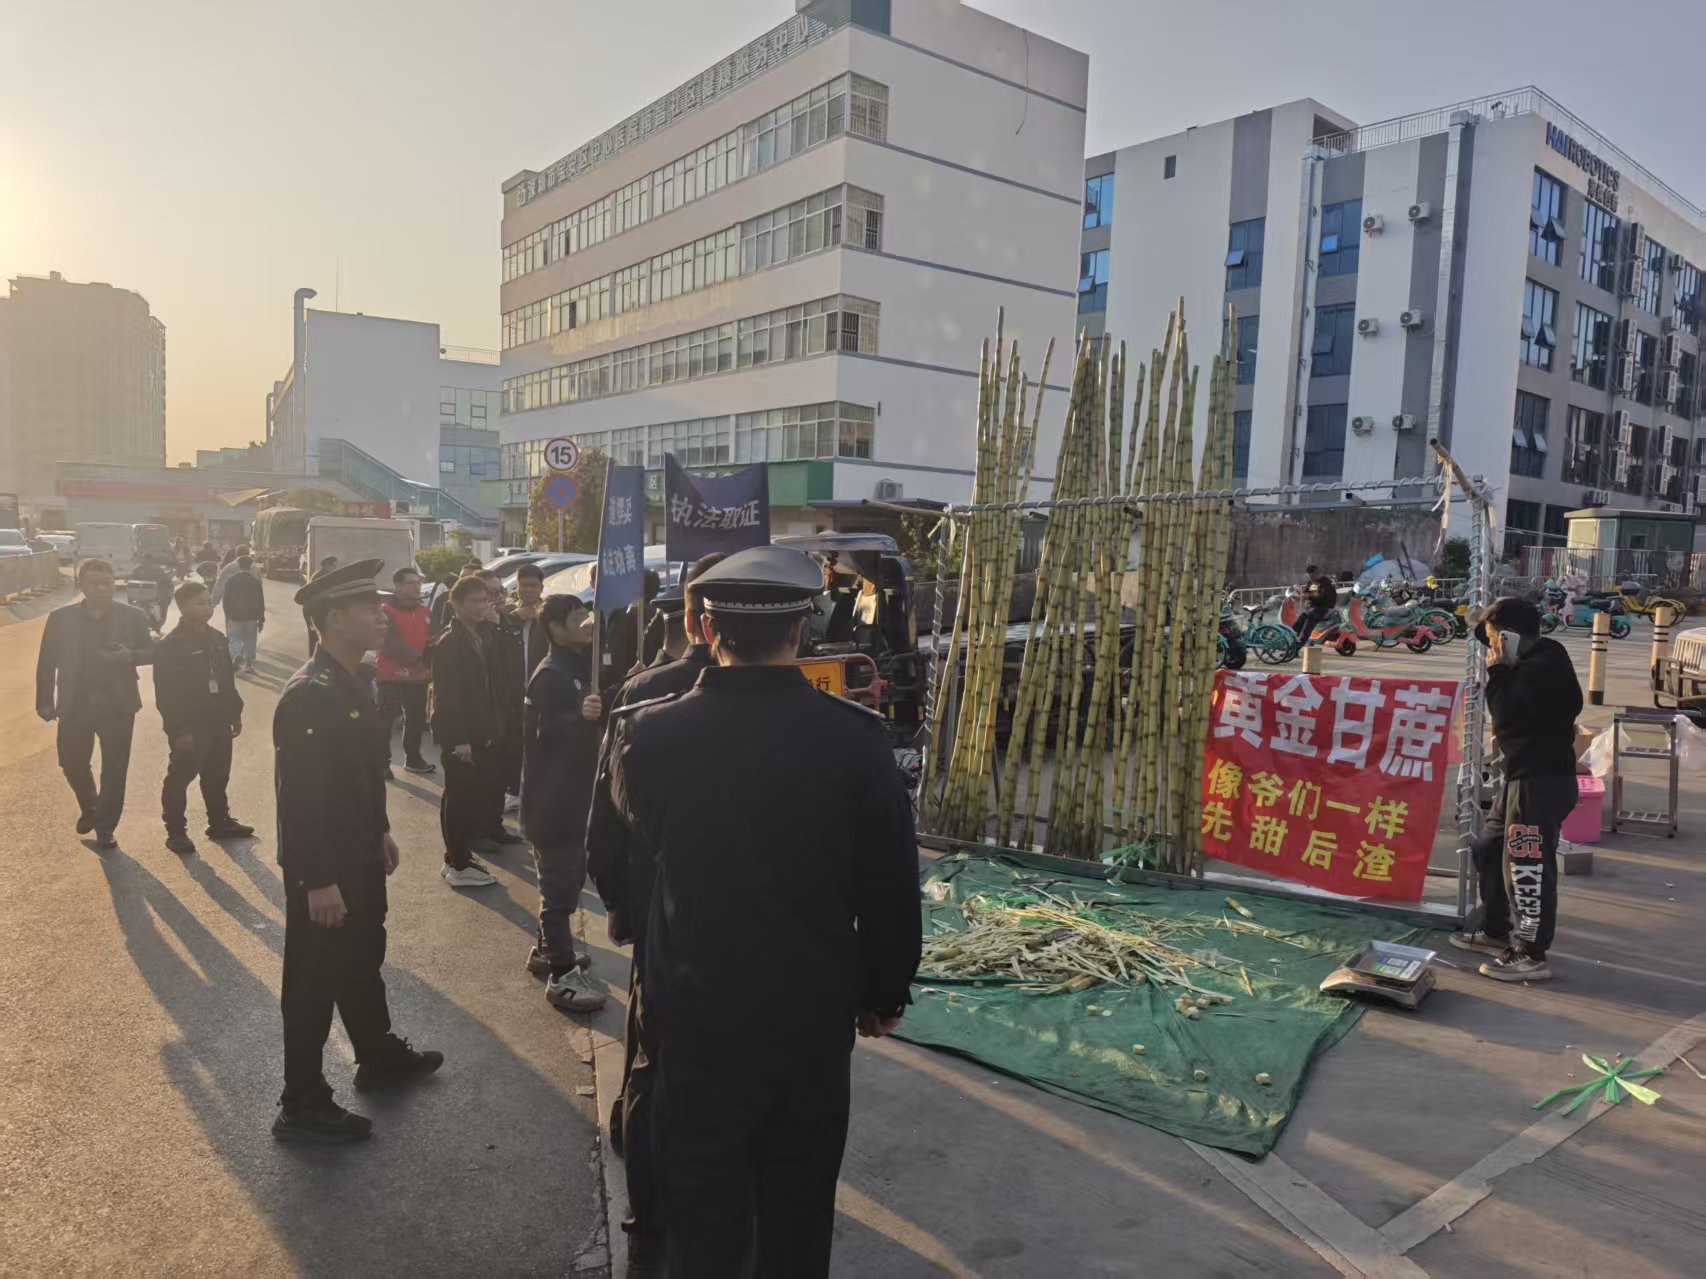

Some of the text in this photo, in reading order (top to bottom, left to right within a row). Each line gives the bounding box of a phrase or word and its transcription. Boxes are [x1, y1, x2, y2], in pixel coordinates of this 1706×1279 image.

[551, 446, 571, 464] 15
[671, 493, 760, 529] 执法取证
[1214, 672, 1452, 781] 黄金甘蔗
[1208, 758, 1408, 840] 像爷们一样
[1202, 801, 1395, 882] 先甜后渣
[1510, 862, 1543, 915] KEEP
